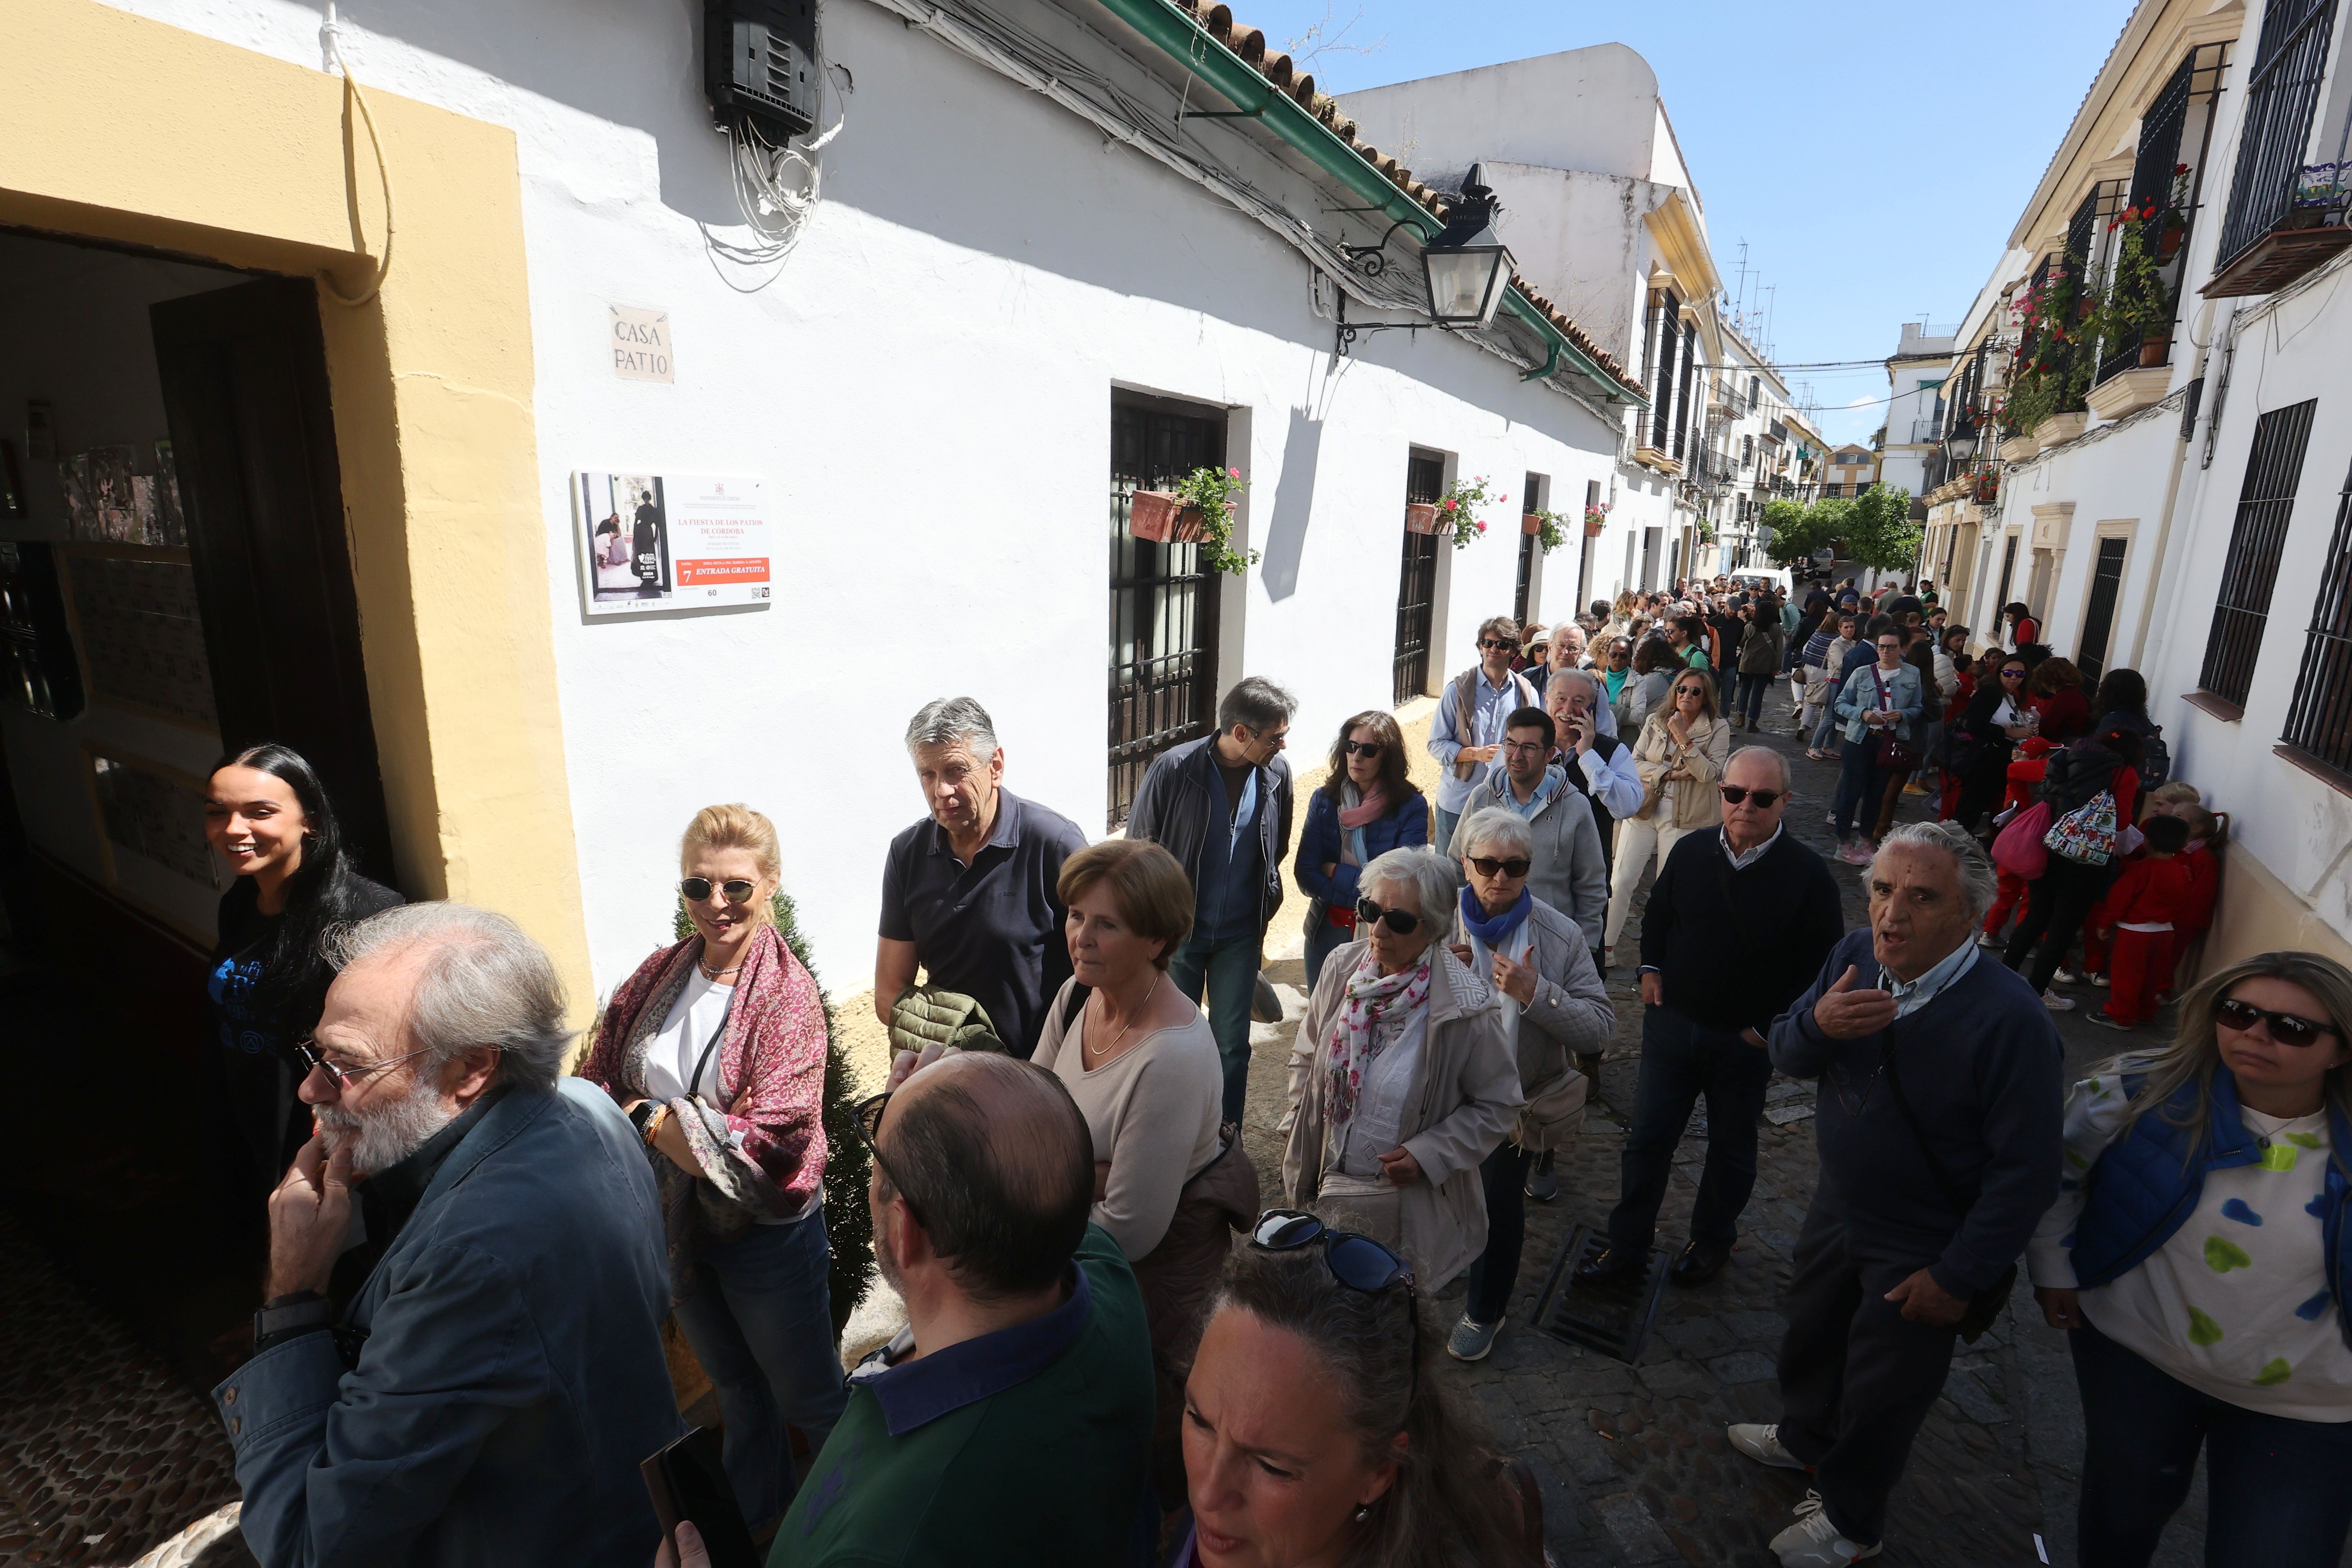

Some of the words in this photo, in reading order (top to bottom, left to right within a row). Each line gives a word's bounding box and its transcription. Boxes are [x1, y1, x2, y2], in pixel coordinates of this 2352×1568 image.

[615, 321, 662, 346] CASA
[614, 349, 667, 374] PATIO
[683, 570, 692, 583] 7
